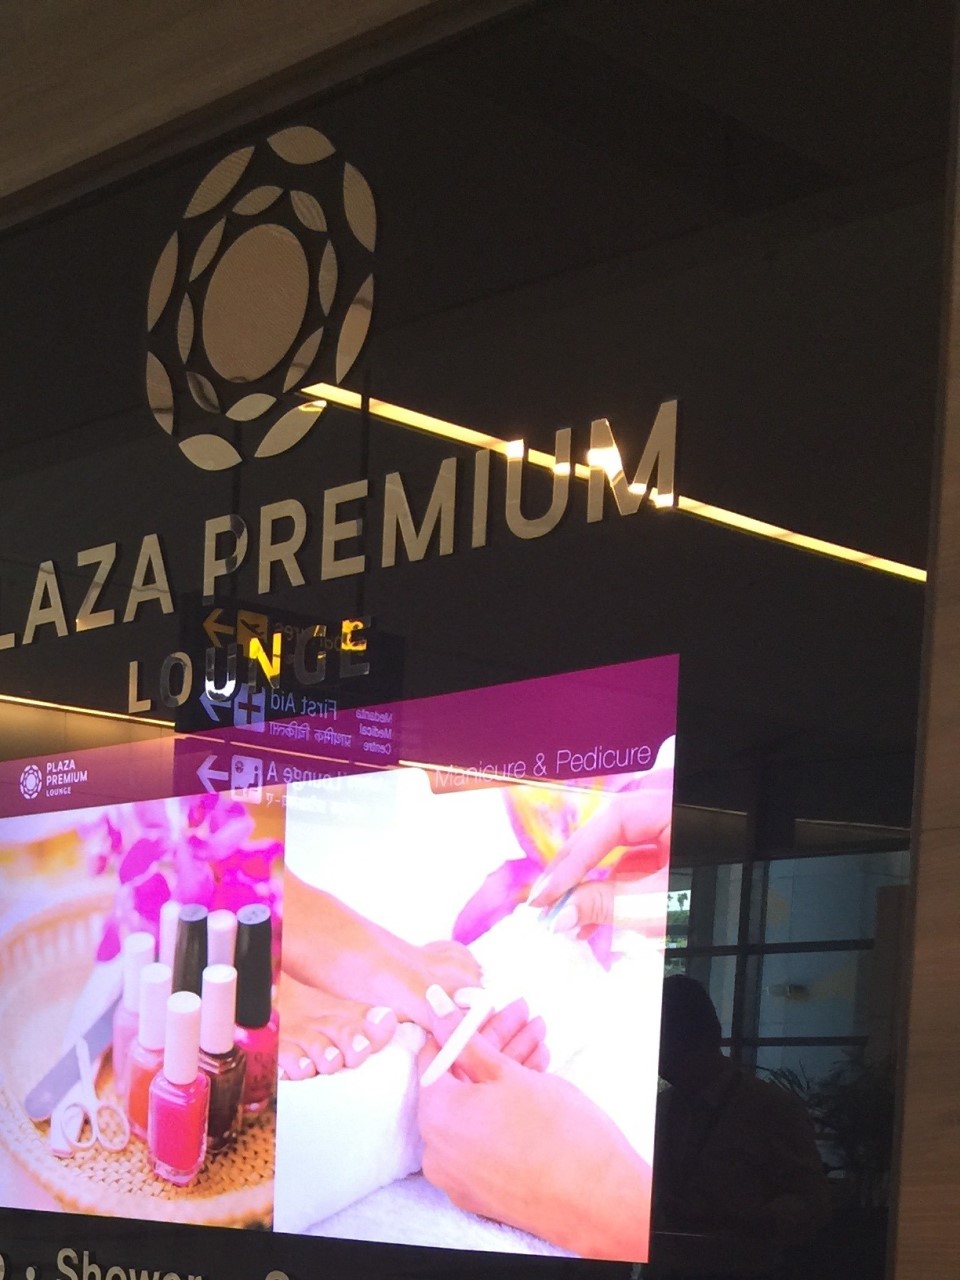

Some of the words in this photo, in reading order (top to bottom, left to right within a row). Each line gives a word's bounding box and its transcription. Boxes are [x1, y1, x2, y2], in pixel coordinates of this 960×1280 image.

[201, 399, 679, 605] PREMIUM
[127, 615, 372, 714] LOUNGE
[46, 759, 76, 773] PLAZA
[46, 770, 88, 786] PREMIUM
[434, 761, 527, 788] Manicure
[532, 752, 548, 777] &
[556, 744, 652, 774] Pedicure
[45, 786, 72, 797] LOUNGE
